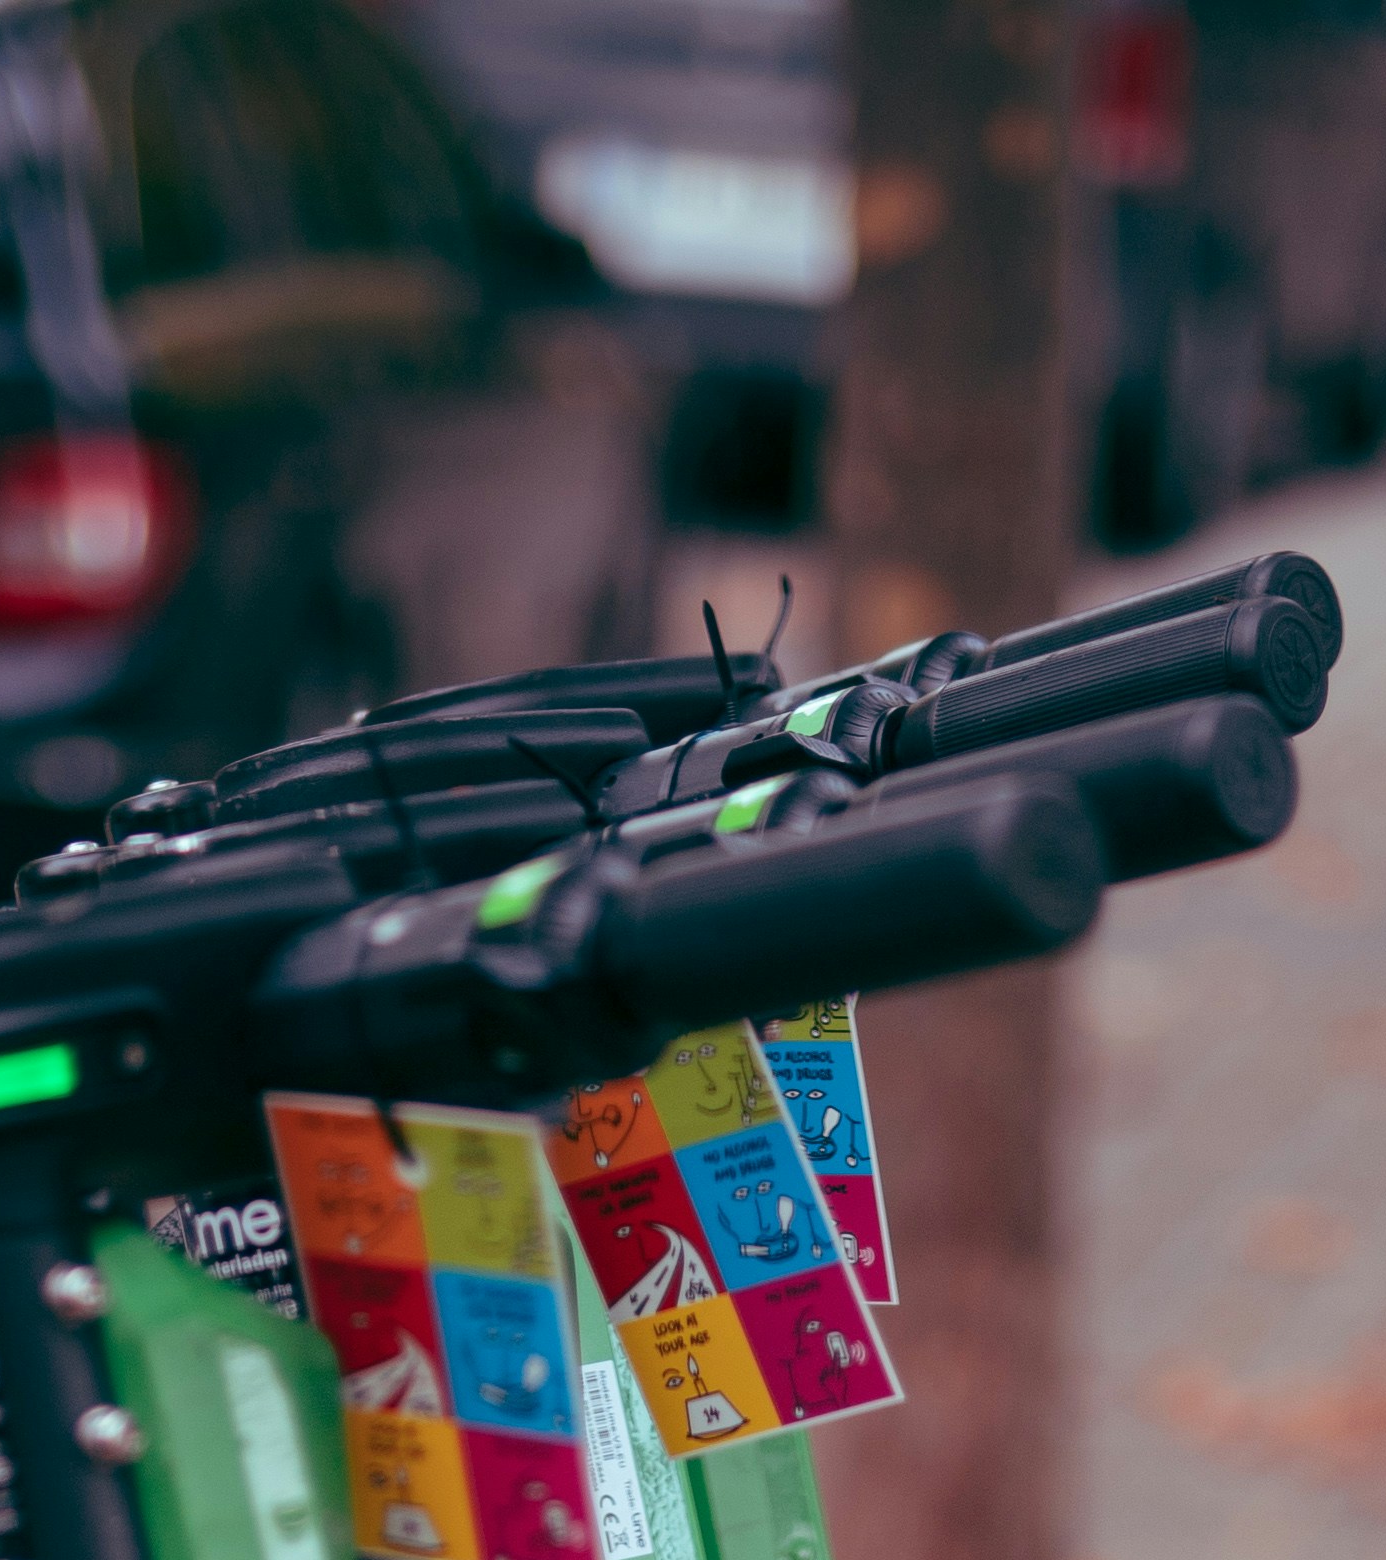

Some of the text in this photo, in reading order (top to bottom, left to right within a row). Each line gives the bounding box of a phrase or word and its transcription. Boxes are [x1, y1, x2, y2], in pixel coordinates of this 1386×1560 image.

[653, 1319, 685, 1338] LOOK
[655, 1330, 711, 1358] YOUR AGE
[703, 1406, 721, 1425] 14
